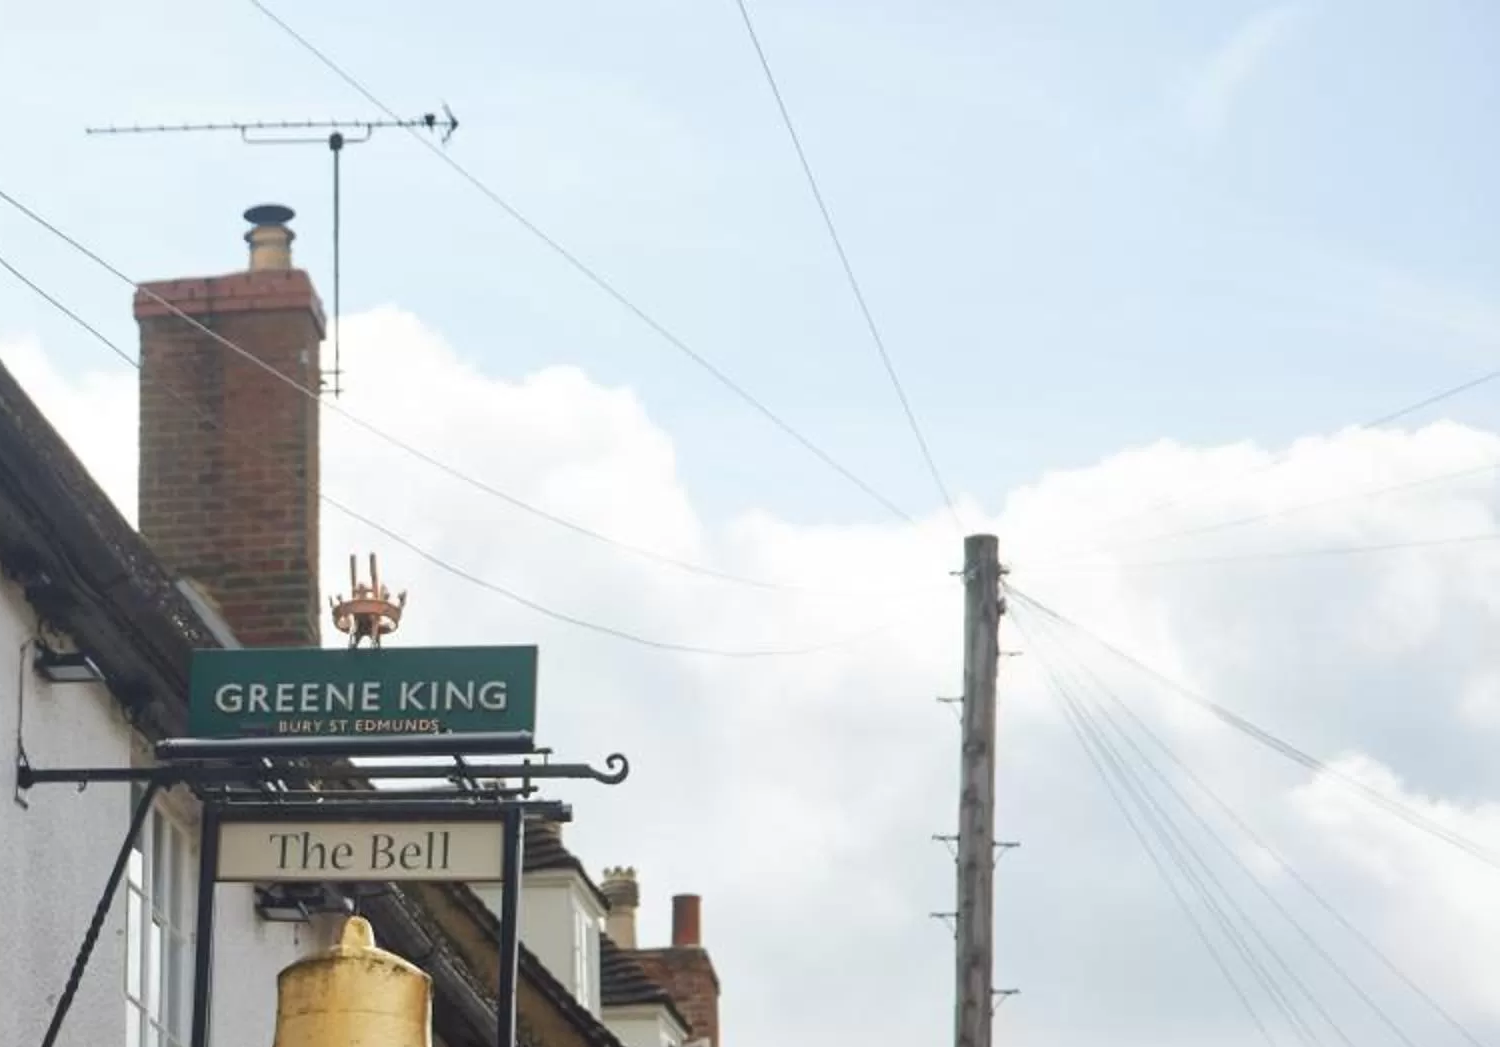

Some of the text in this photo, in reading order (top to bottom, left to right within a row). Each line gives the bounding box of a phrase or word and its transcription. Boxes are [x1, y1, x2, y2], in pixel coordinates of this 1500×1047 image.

[215, 681, 507, 713] GREENE KING
[279, 718, 439, 733] BURY ST EDMUNDS
[269, 831, 451, 871] The Bell
